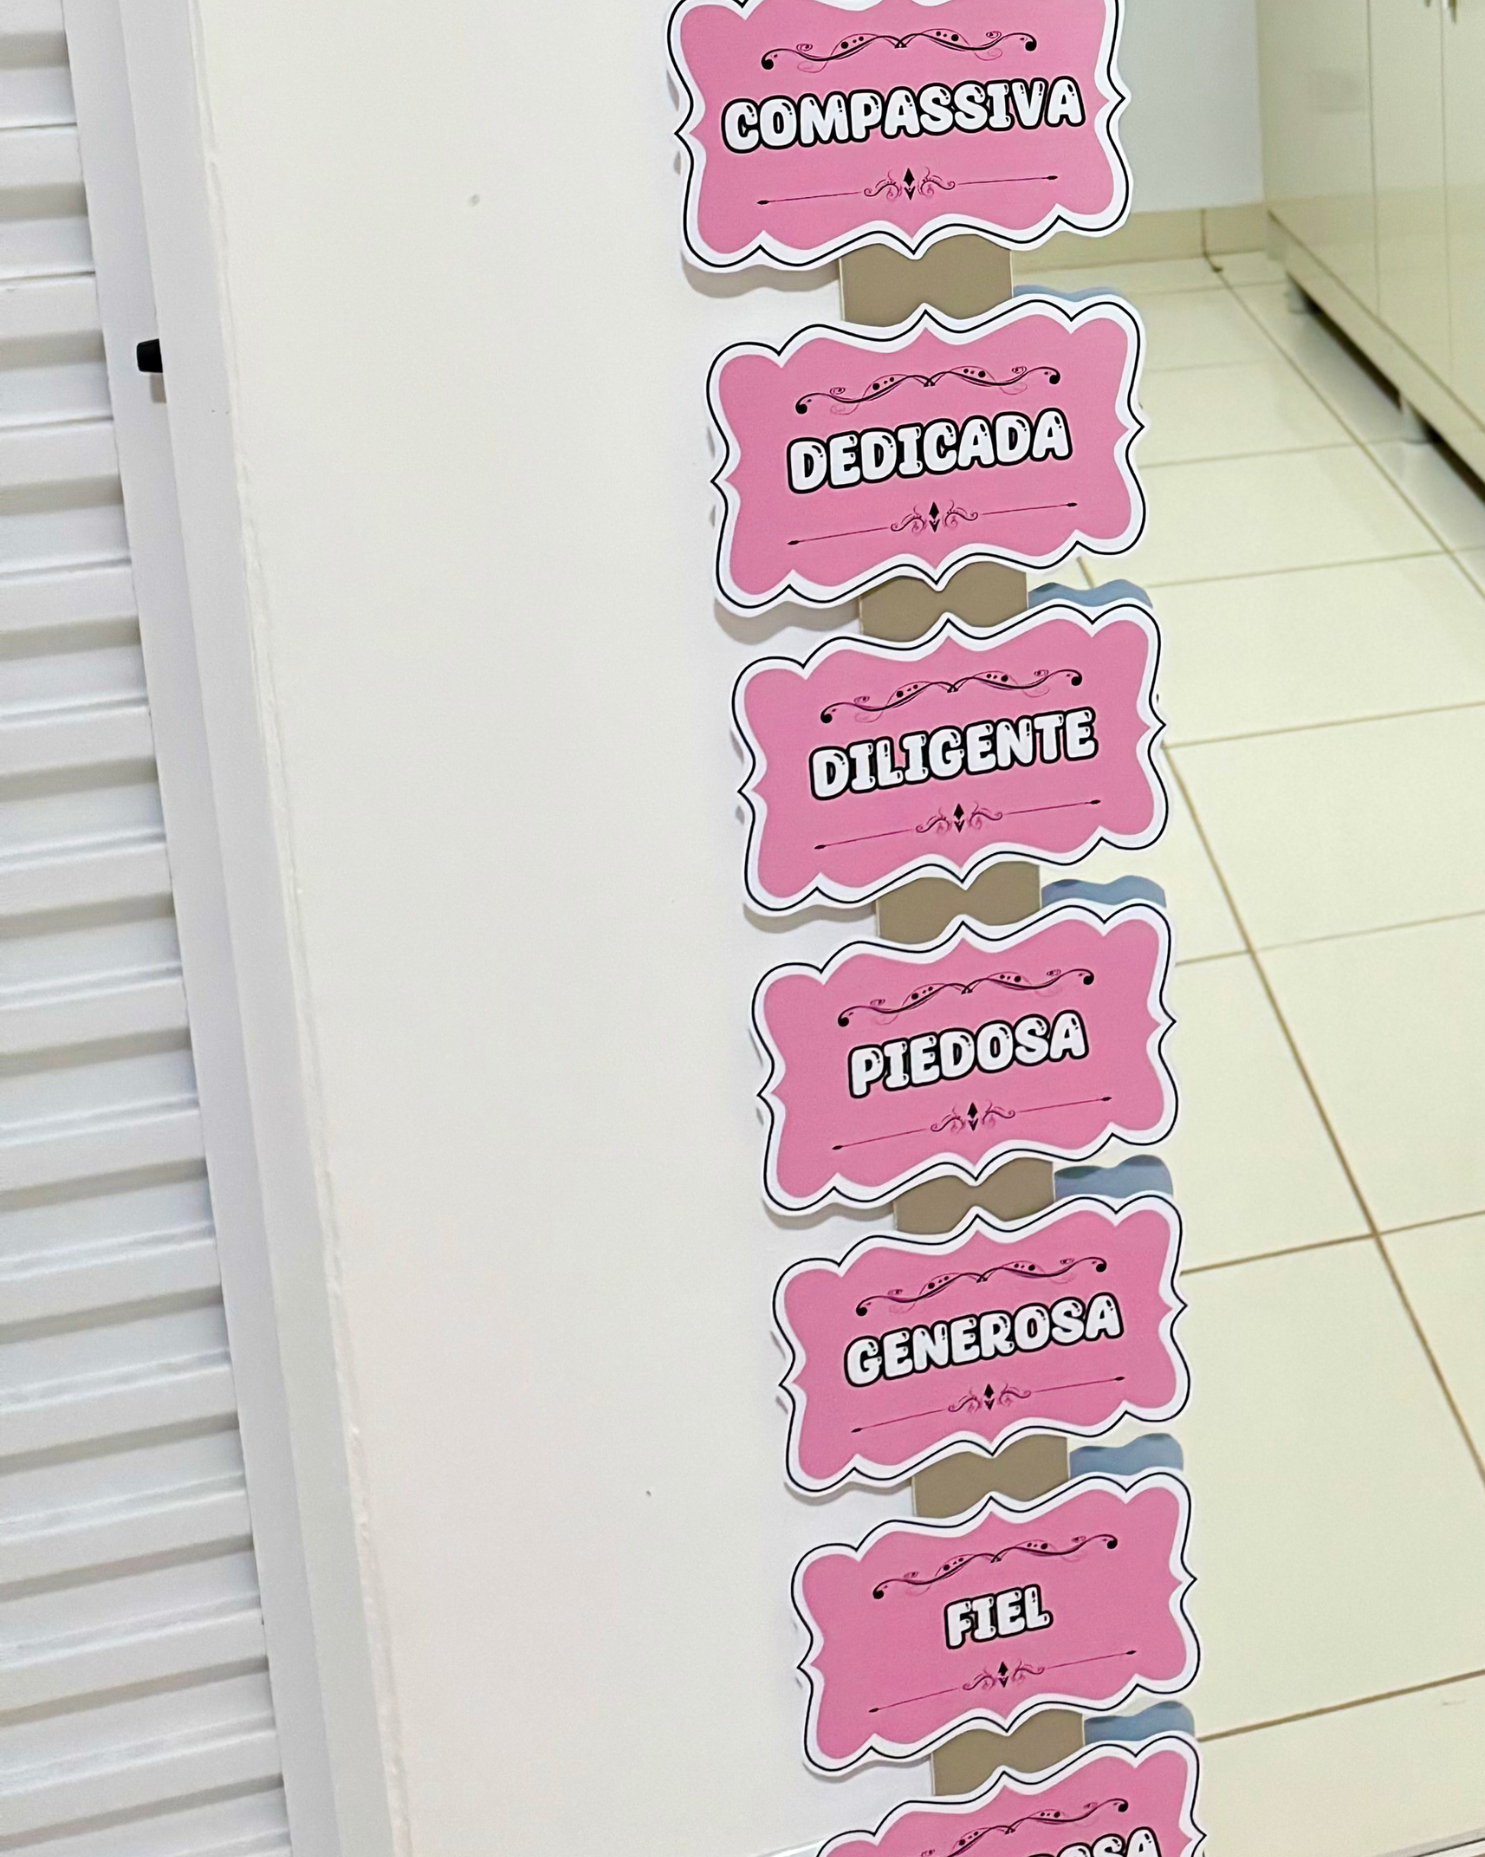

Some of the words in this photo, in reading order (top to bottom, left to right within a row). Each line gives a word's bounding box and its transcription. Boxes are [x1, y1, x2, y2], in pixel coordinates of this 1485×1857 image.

[721, 76, 1085, 153] COMPASSIVA
[787, 408, 1072, 494] DEDICADA
[809, 707, 1098, 800] DILIGENTE
[848, 1010, 1089, 1098] PIEDOSA
[844, 1292, 1124, 1387] GENEROSA
[944, 1584, 1053, 1649] FIEL
